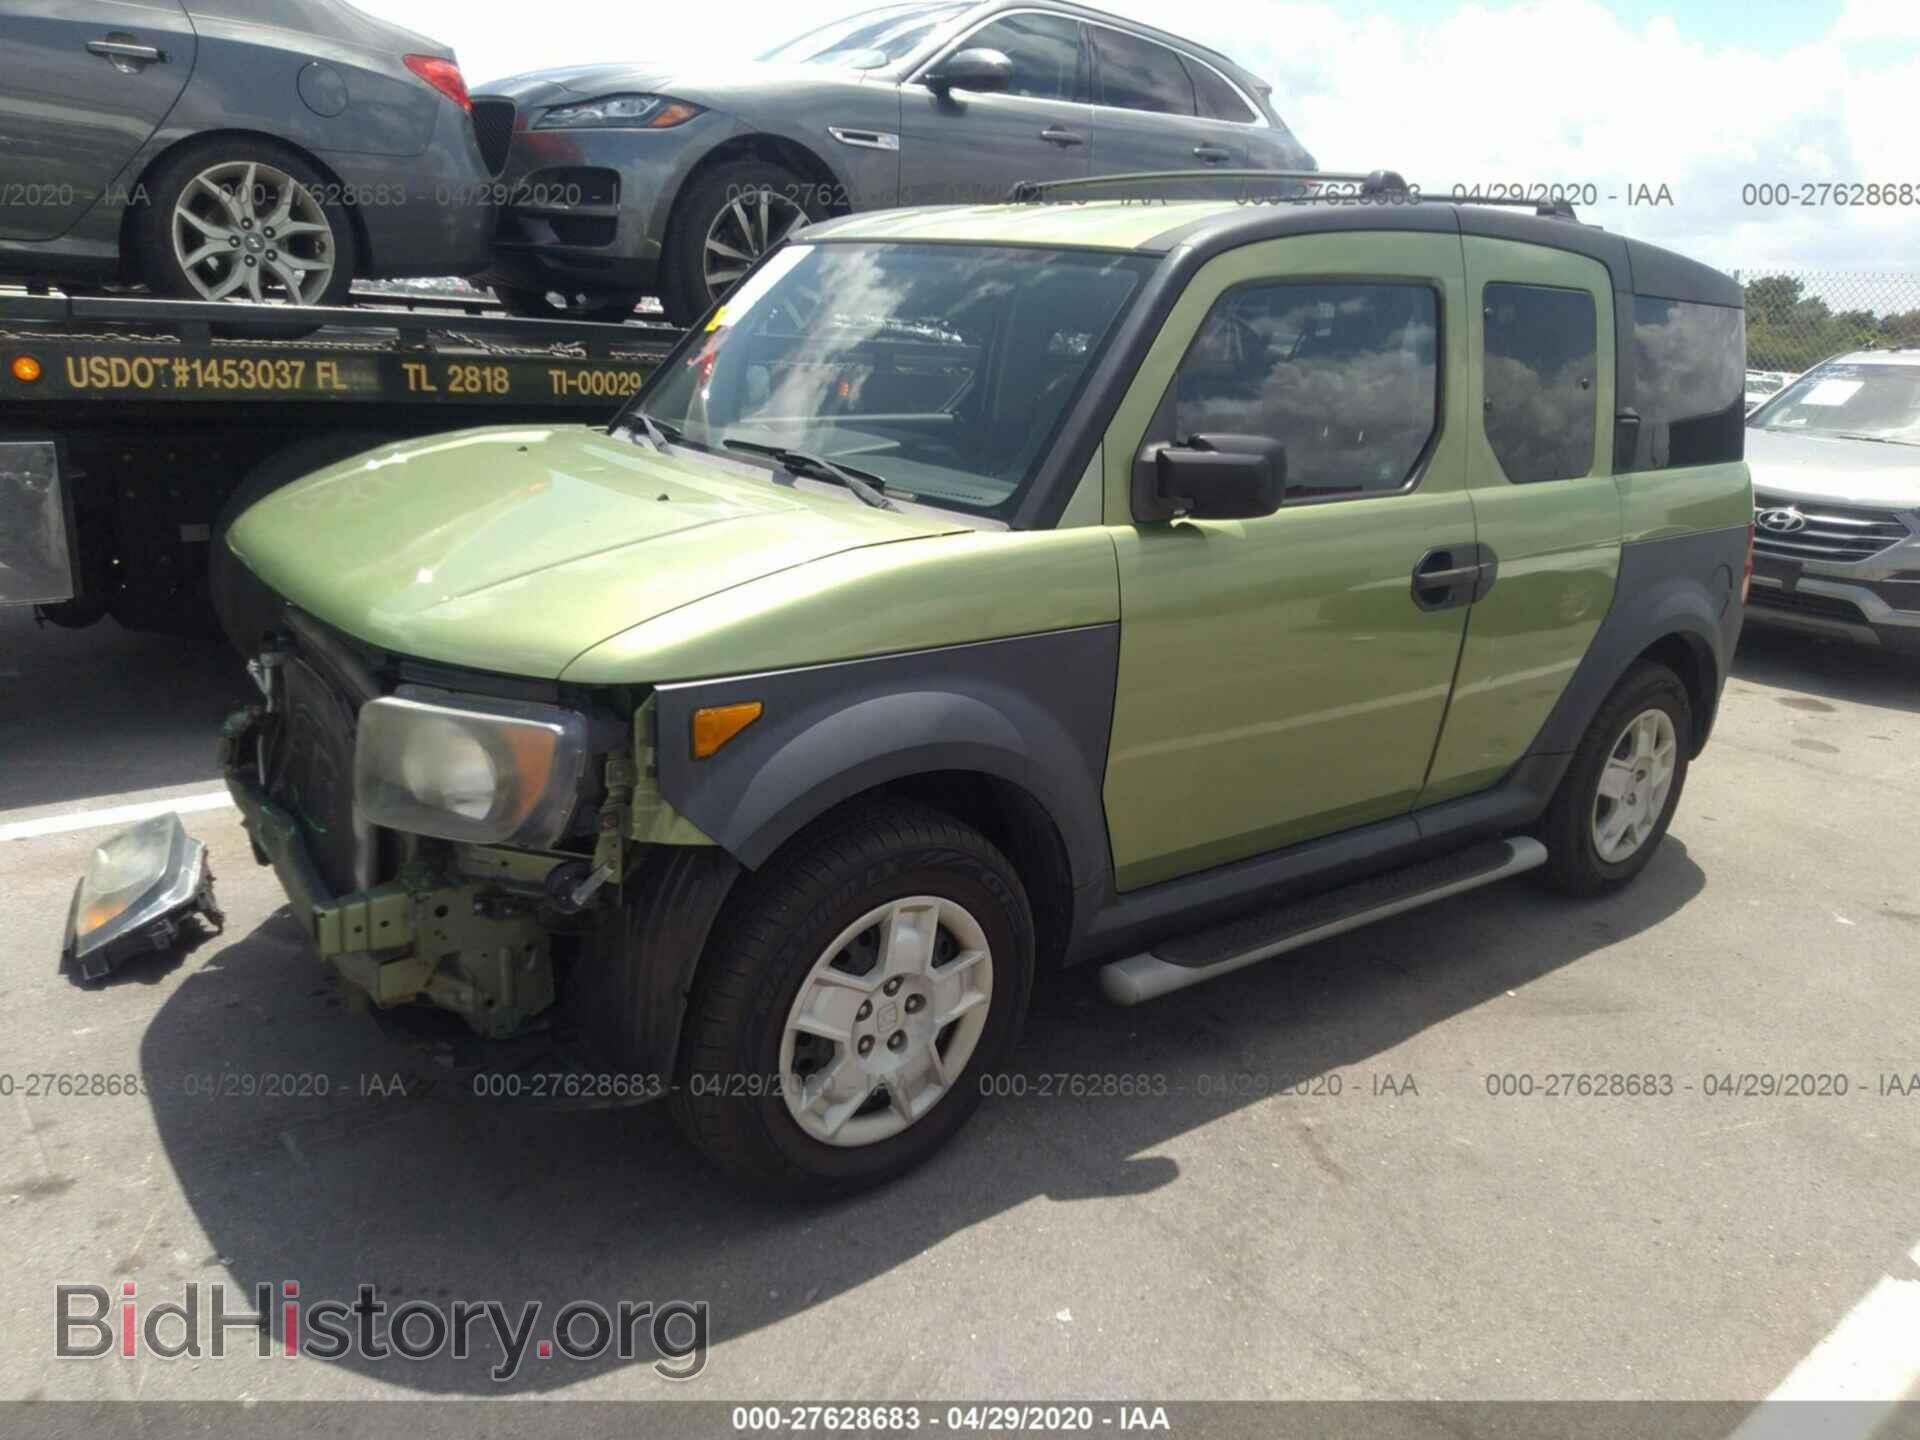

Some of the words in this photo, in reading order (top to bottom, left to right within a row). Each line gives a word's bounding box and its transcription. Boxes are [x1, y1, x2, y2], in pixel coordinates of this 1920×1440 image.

[316, 360, 347, 390] FL
[402, 363, 438, 393] TL
[448, 365, 510, 394] 2818
[549, 369, 641, 397] TI-00029
